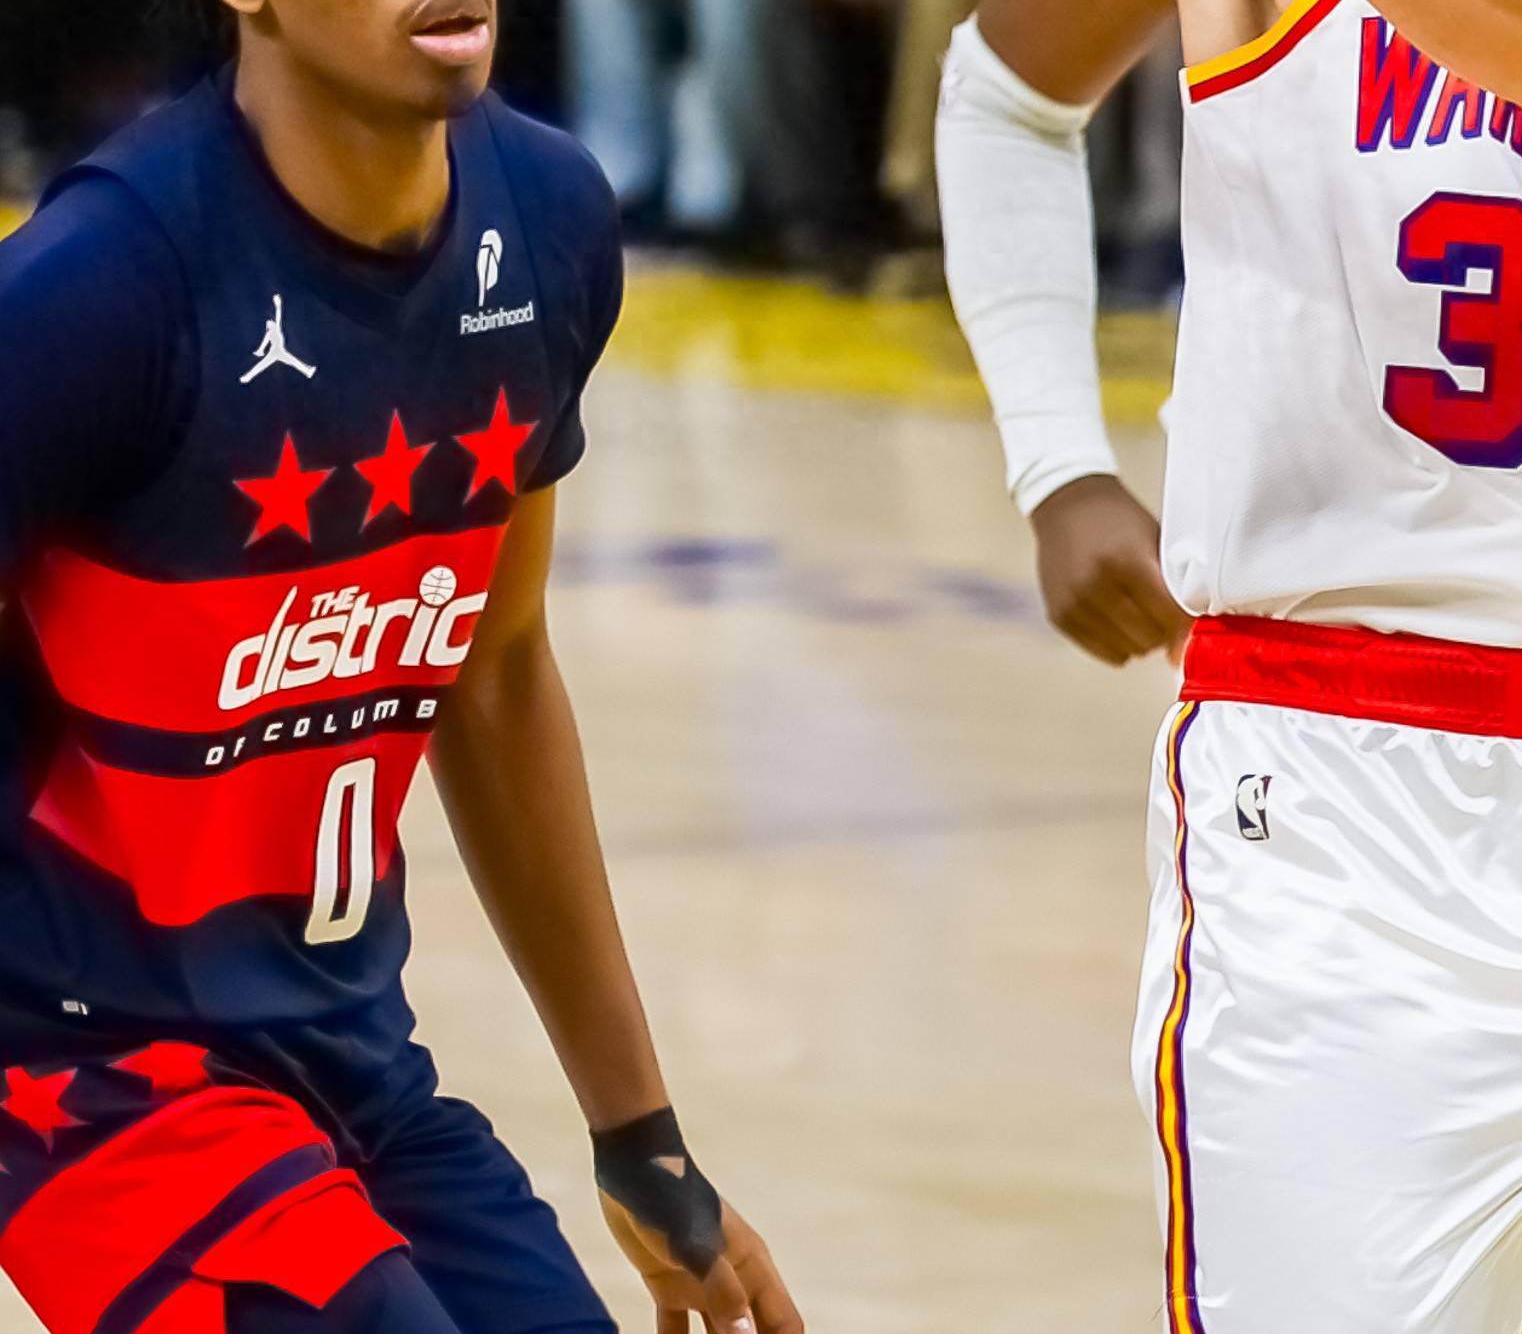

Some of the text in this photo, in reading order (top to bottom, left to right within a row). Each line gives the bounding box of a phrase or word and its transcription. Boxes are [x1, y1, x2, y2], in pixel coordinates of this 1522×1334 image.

[460, 301, 534, 335] Robinhood
[310, 585, 361, 618] THE
[304, 757, 376, 946] 0
